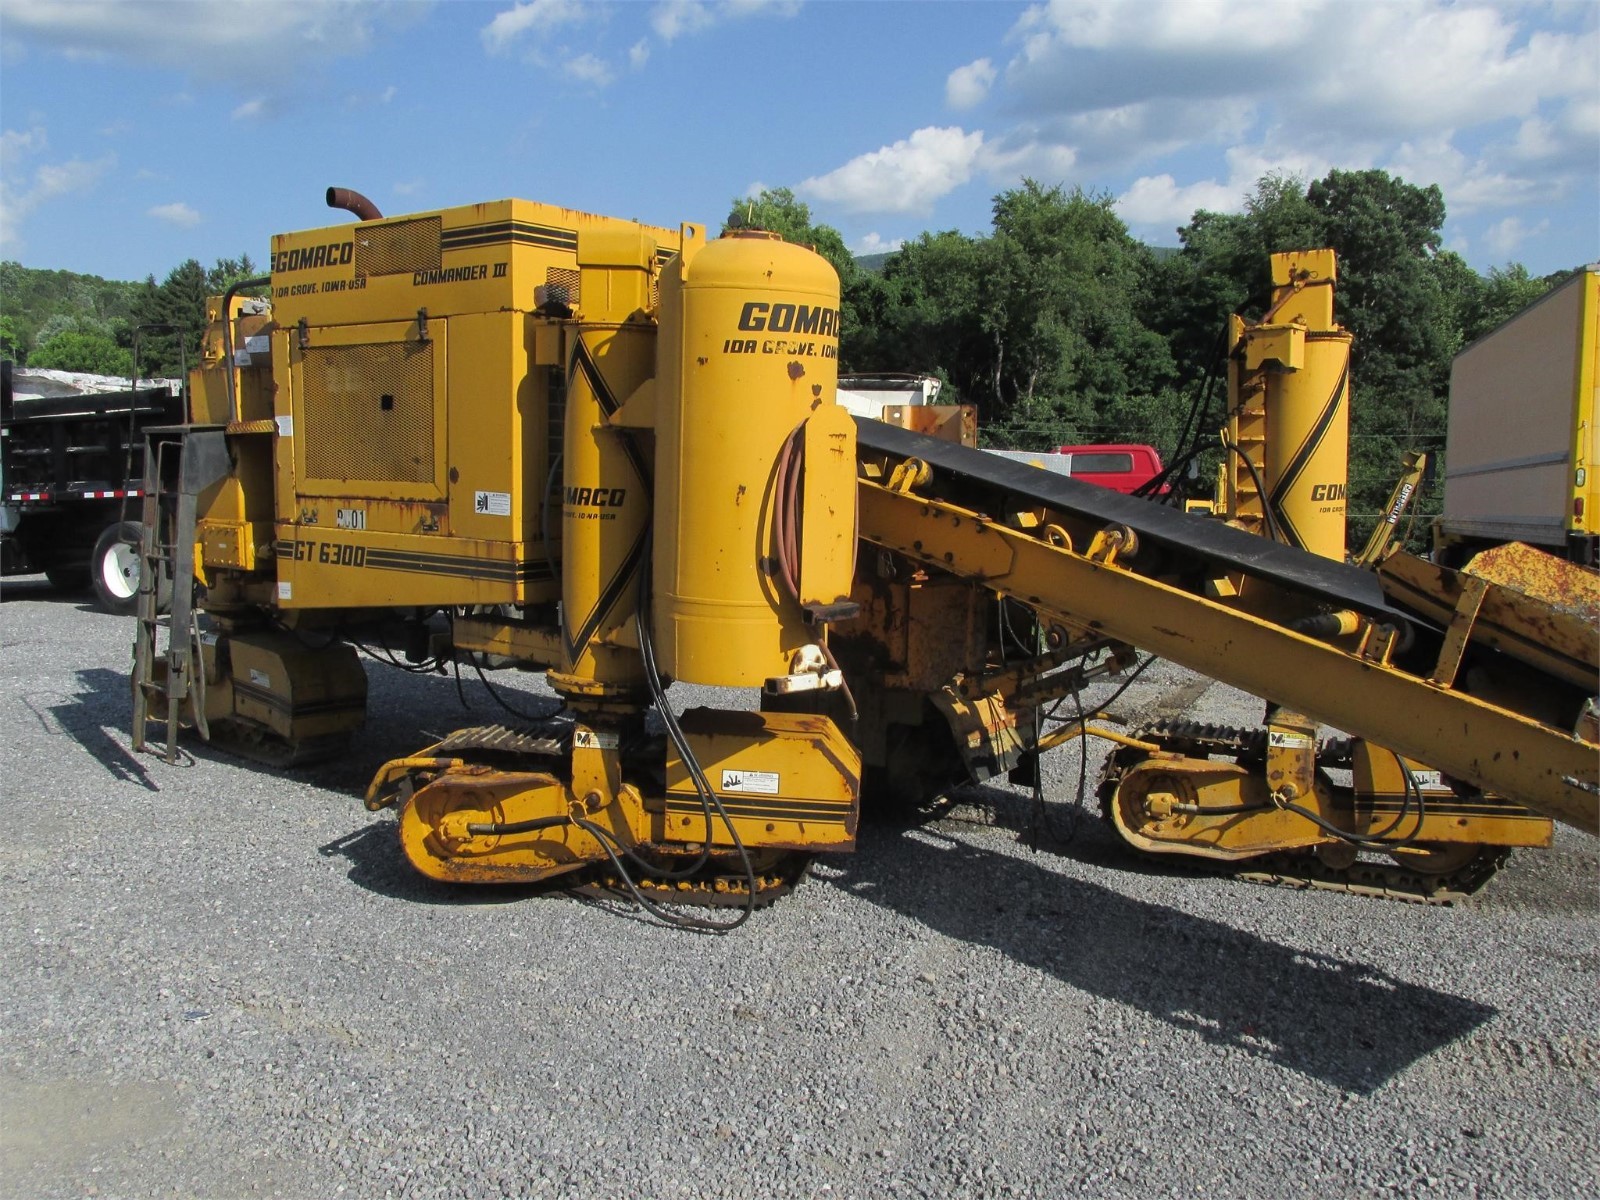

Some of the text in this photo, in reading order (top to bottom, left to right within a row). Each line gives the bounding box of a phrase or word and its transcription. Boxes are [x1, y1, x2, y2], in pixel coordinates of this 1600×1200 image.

[276, 242, 354, 273] GOMACO
[413, 264, 488, 287] COMMANDER
[275, 286, 289, 298] IDA
[723, 340, 757, 354] IDA
[294, 540, 366, 567] GT 6300
